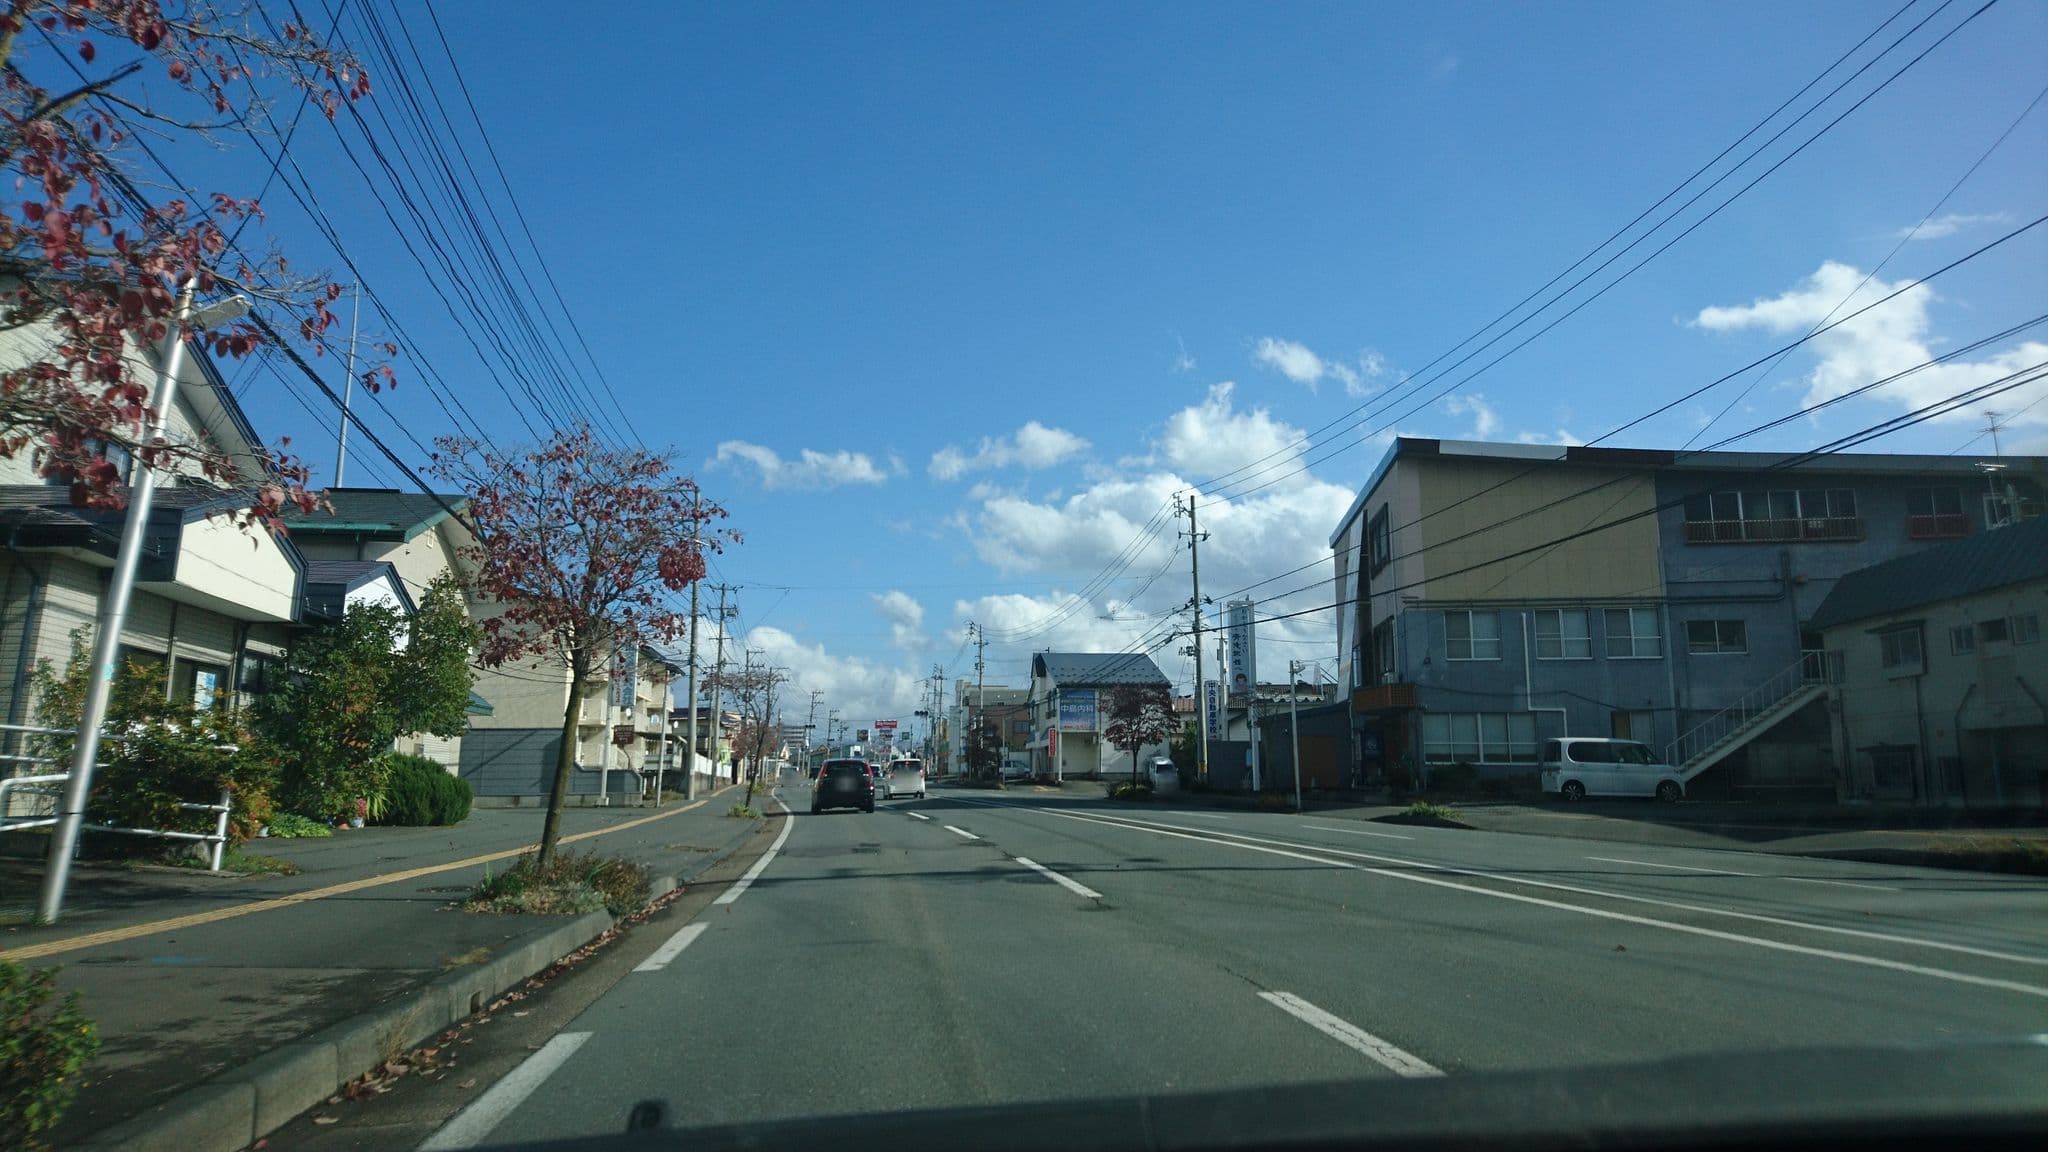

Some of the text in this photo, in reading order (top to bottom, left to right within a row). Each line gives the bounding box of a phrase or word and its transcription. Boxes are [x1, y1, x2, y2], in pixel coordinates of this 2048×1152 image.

[1208, 682, 1217, 733] 中央自動車学校
